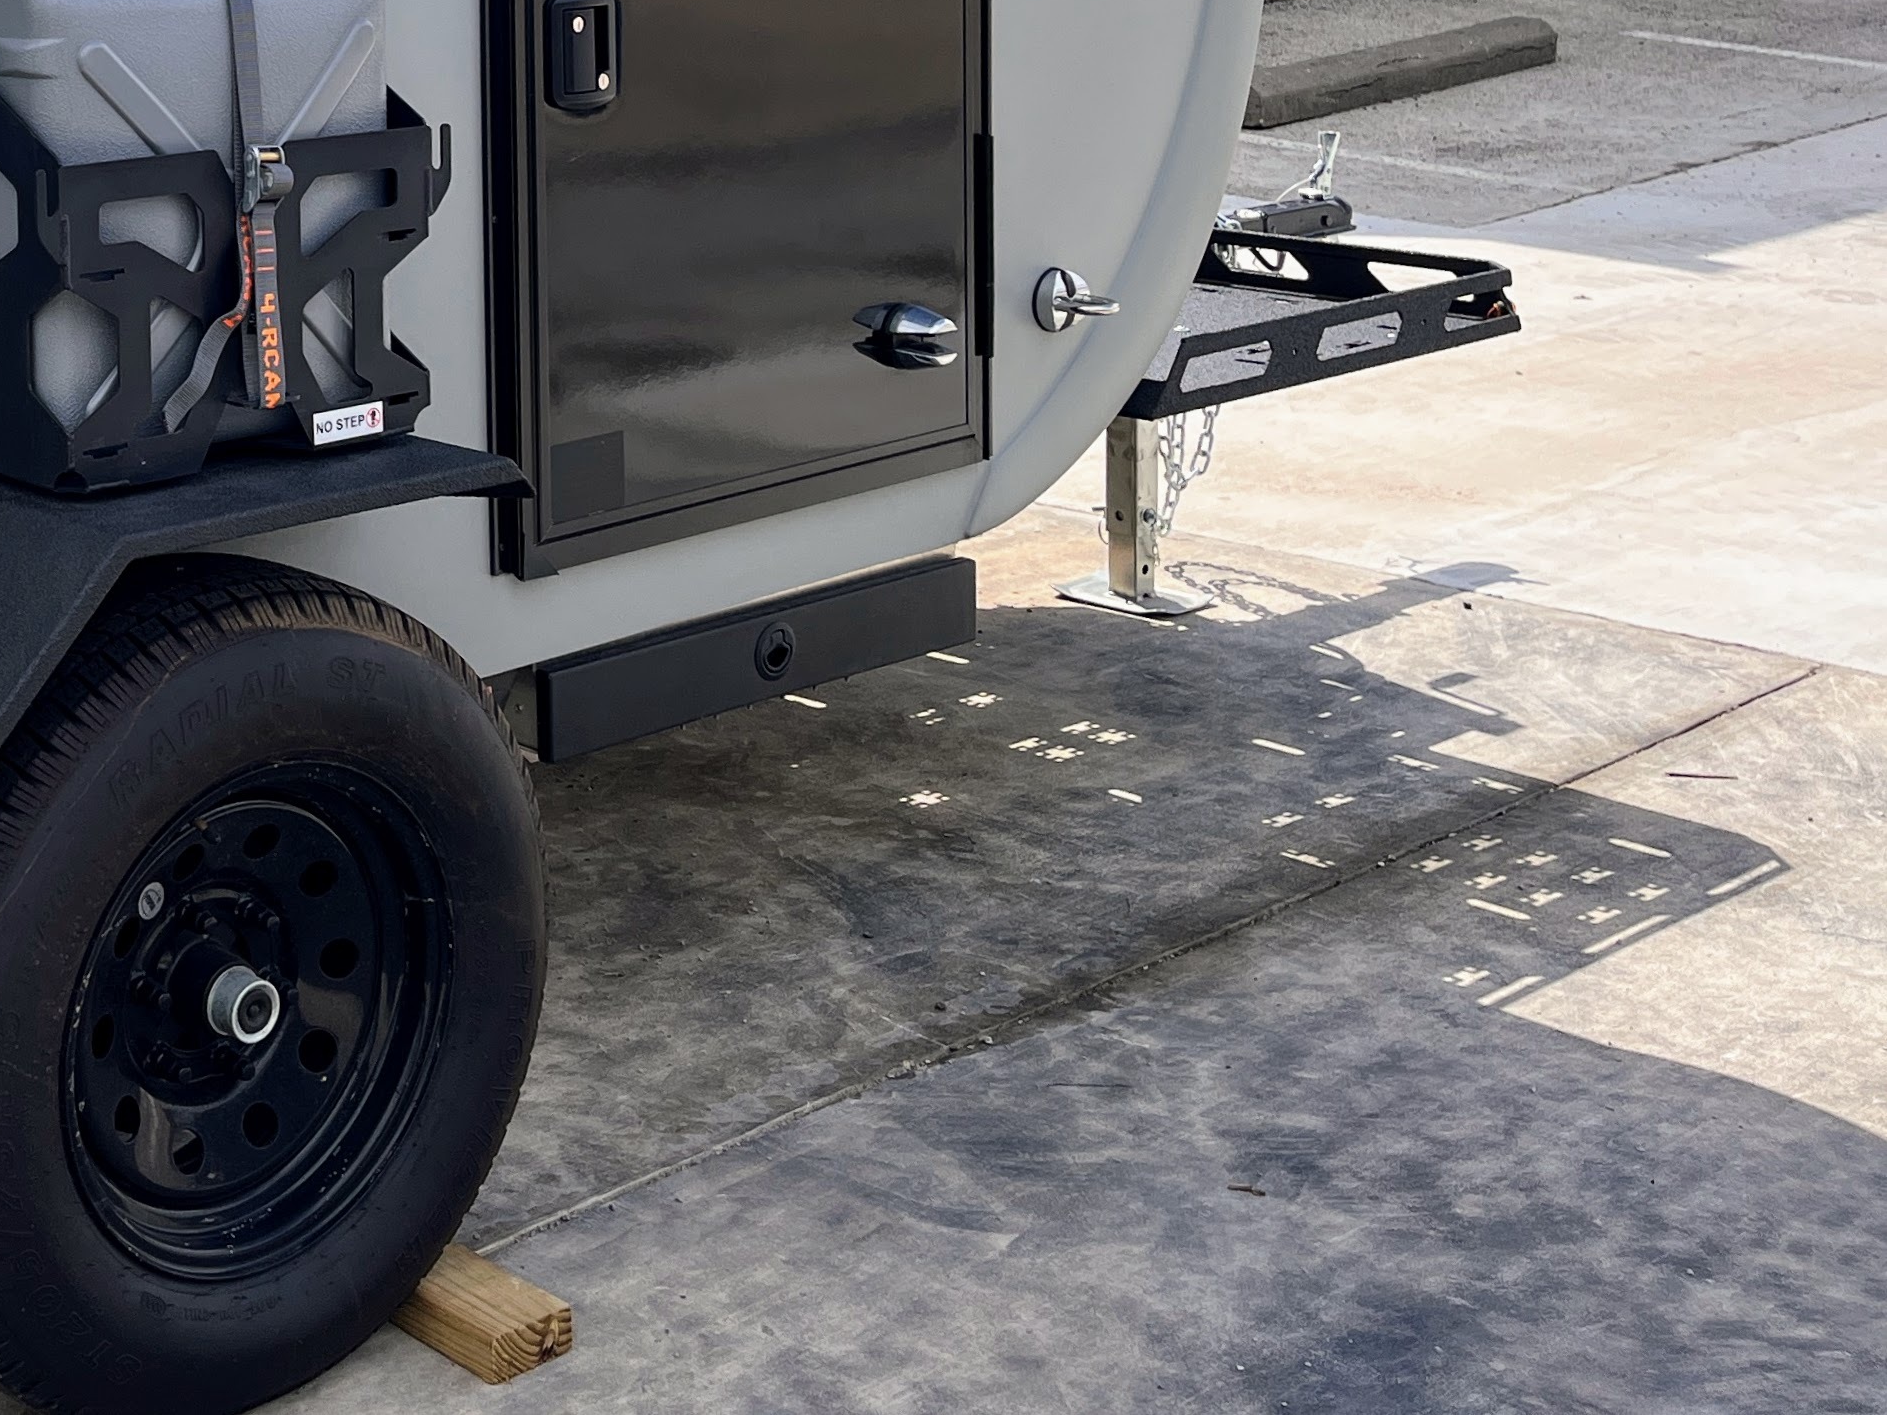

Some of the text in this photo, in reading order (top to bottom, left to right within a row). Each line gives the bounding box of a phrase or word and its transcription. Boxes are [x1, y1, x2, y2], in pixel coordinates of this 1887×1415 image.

[316, 414, 365, 435] NO STEP
[325, 655, 387, 693] ST
